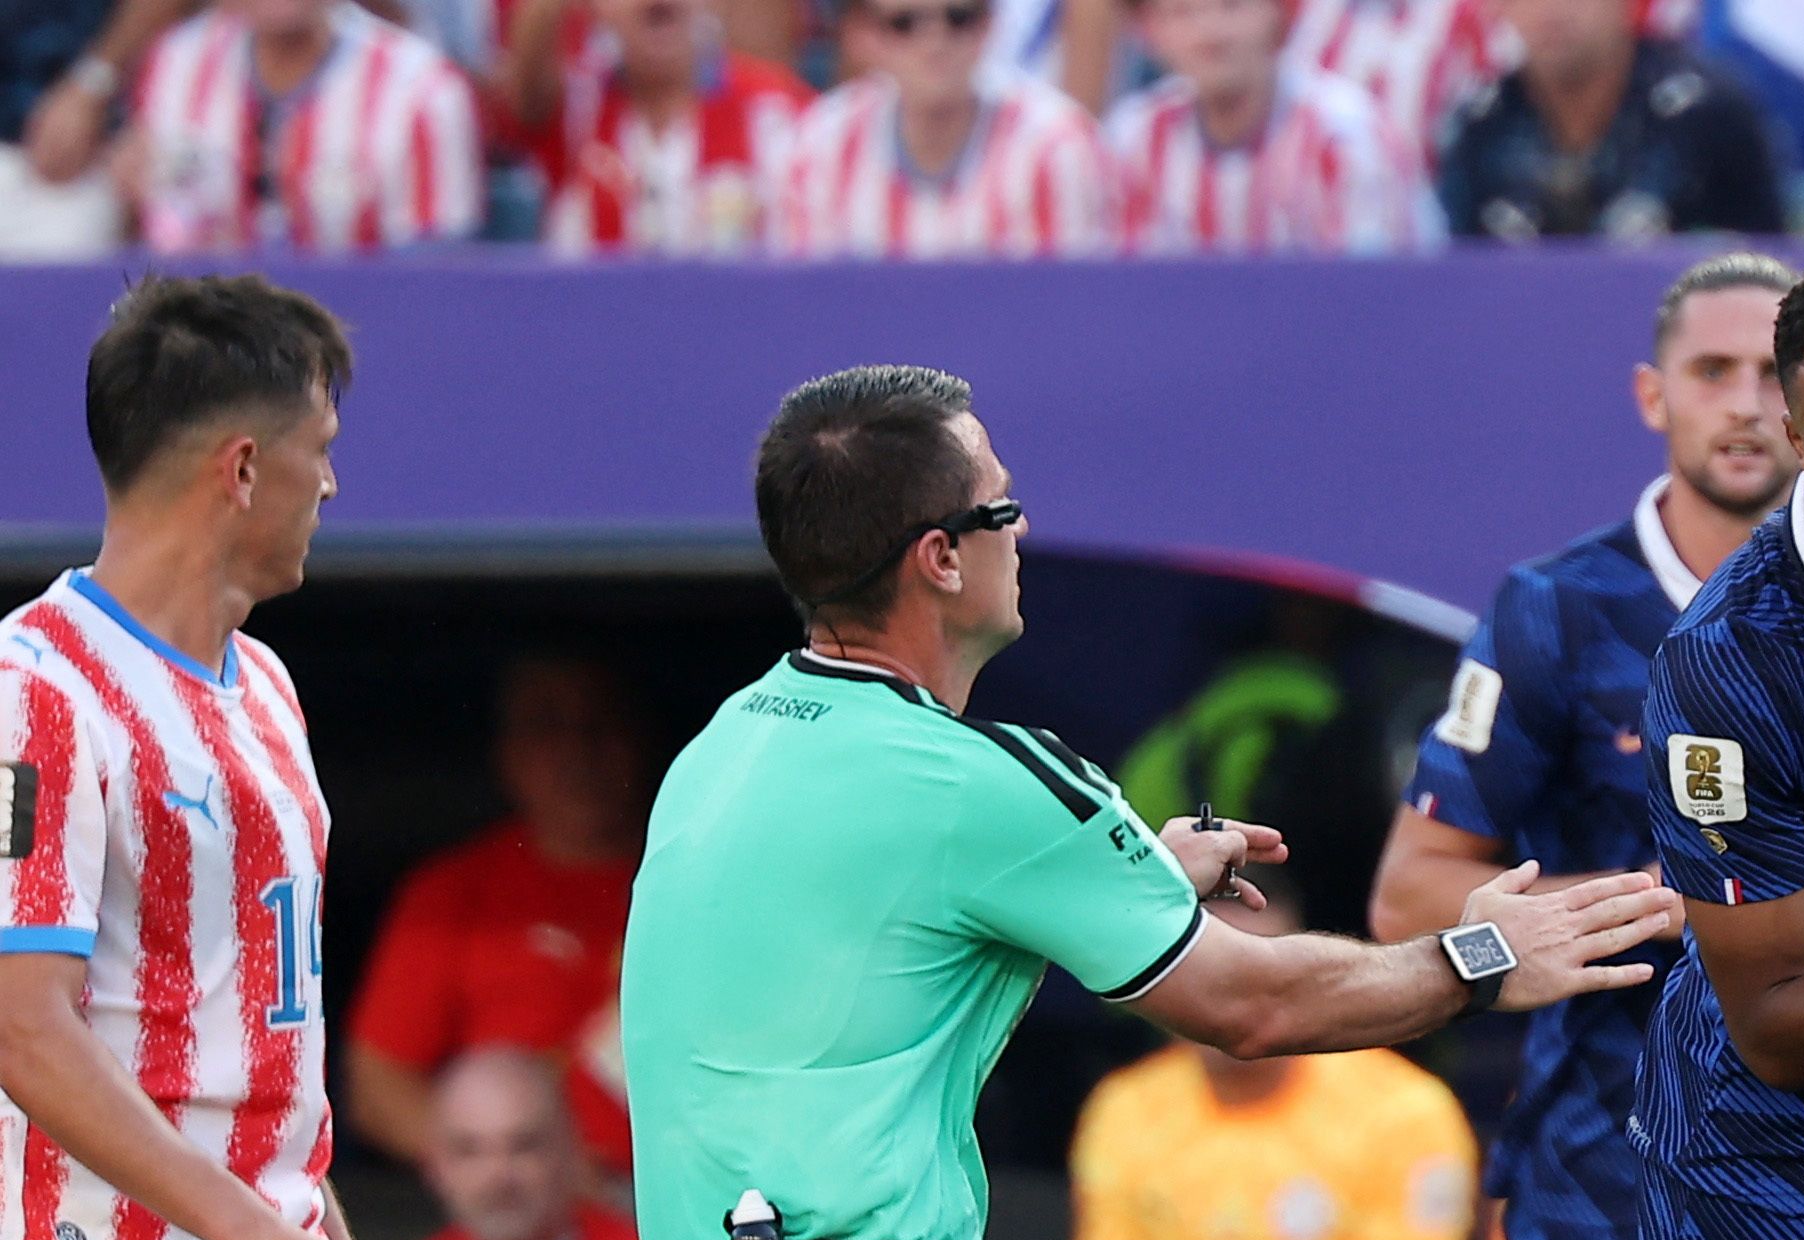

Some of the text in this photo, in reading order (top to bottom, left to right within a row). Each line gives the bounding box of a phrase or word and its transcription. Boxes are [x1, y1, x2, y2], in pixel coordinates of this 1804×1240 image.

[1695, 788, 1714, 798] FIFA
[1108, 820, 1140, 852] FI
[1127, 845, 1153, 866] TEA
